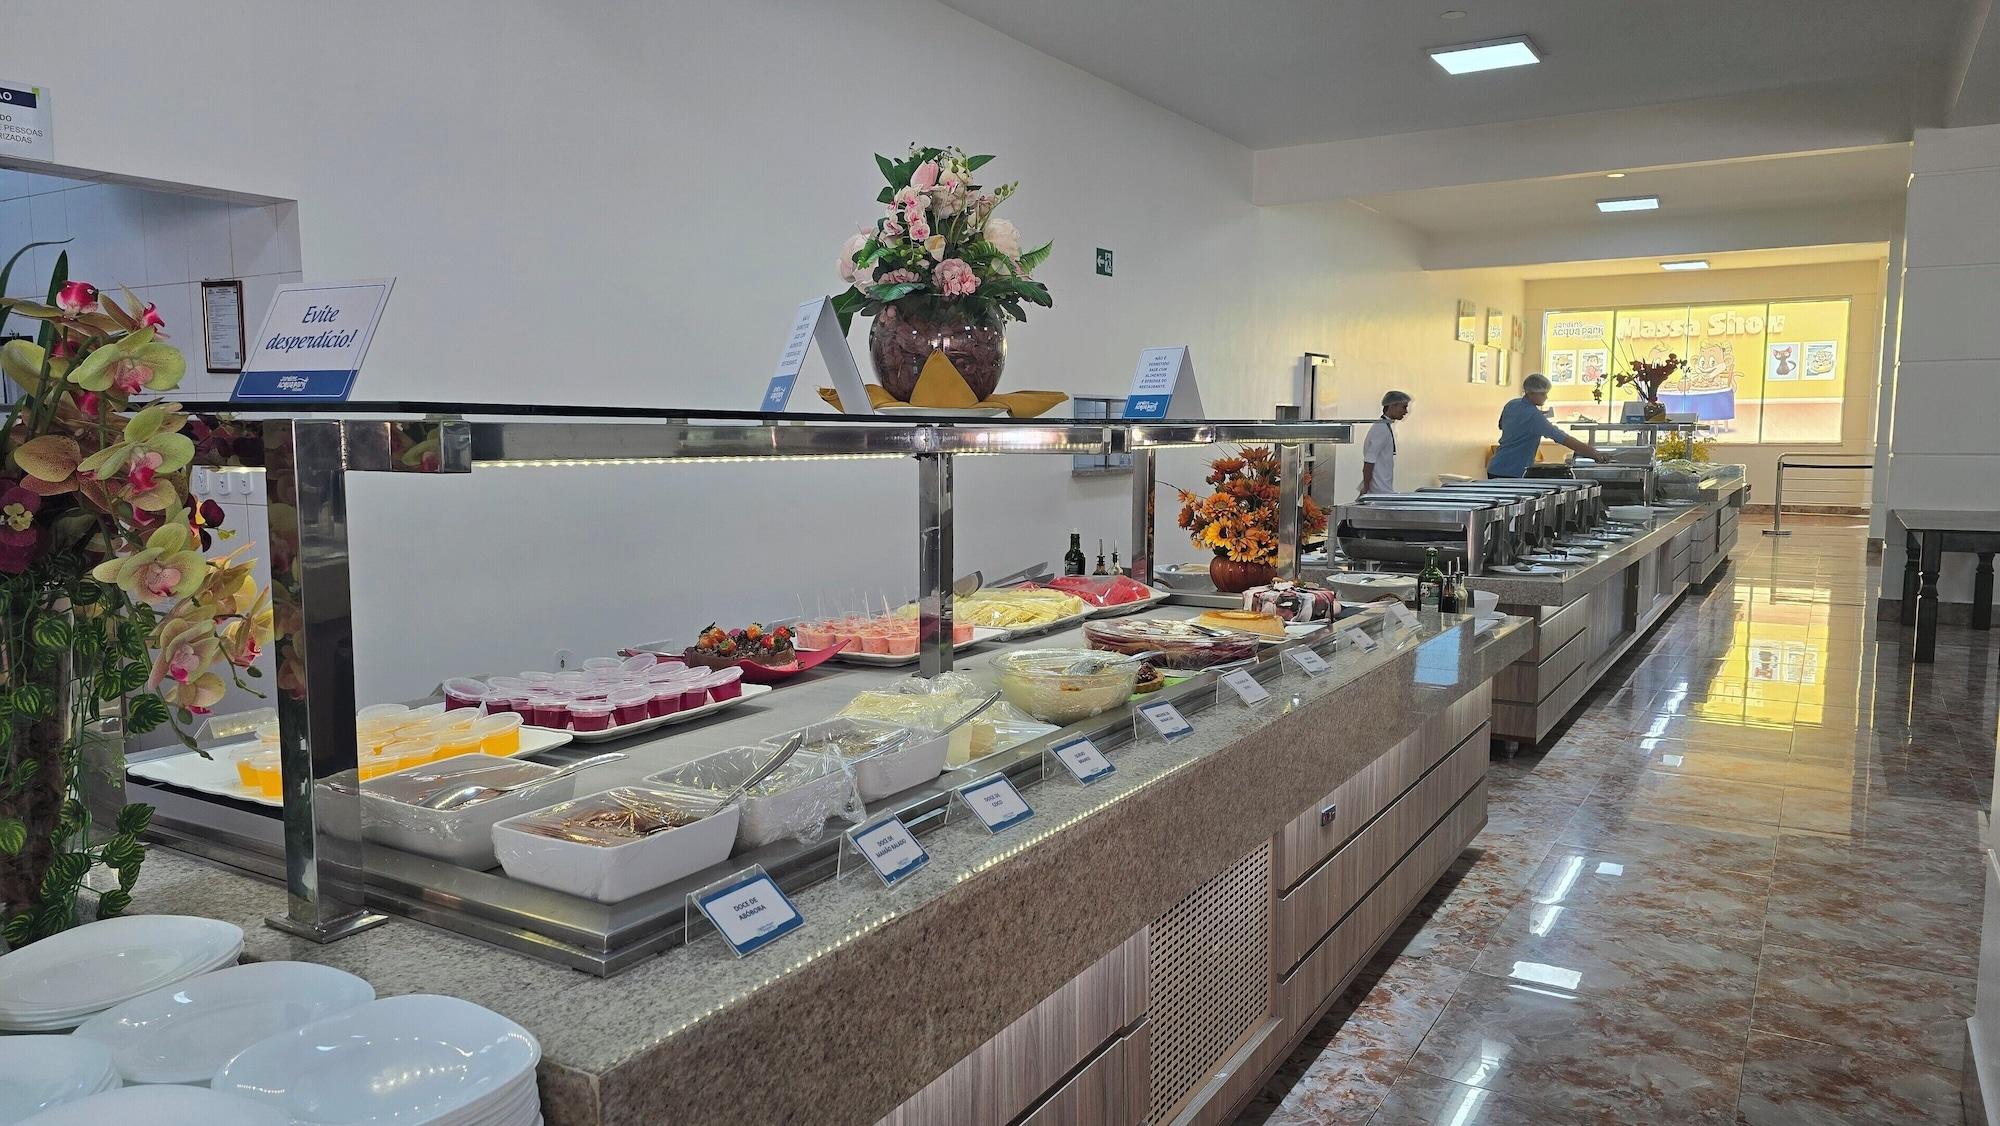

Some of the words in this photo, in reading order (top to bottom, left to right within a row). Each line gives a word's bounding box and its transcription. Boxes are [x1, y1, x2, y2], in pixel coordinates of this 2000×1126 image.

[4, 124, 43, 136] PESSOAS
[301, 304, 340, 324] Evite
[1616, 316, 1701, 340] Massa
[733, 900, 750, 911] DOCE
